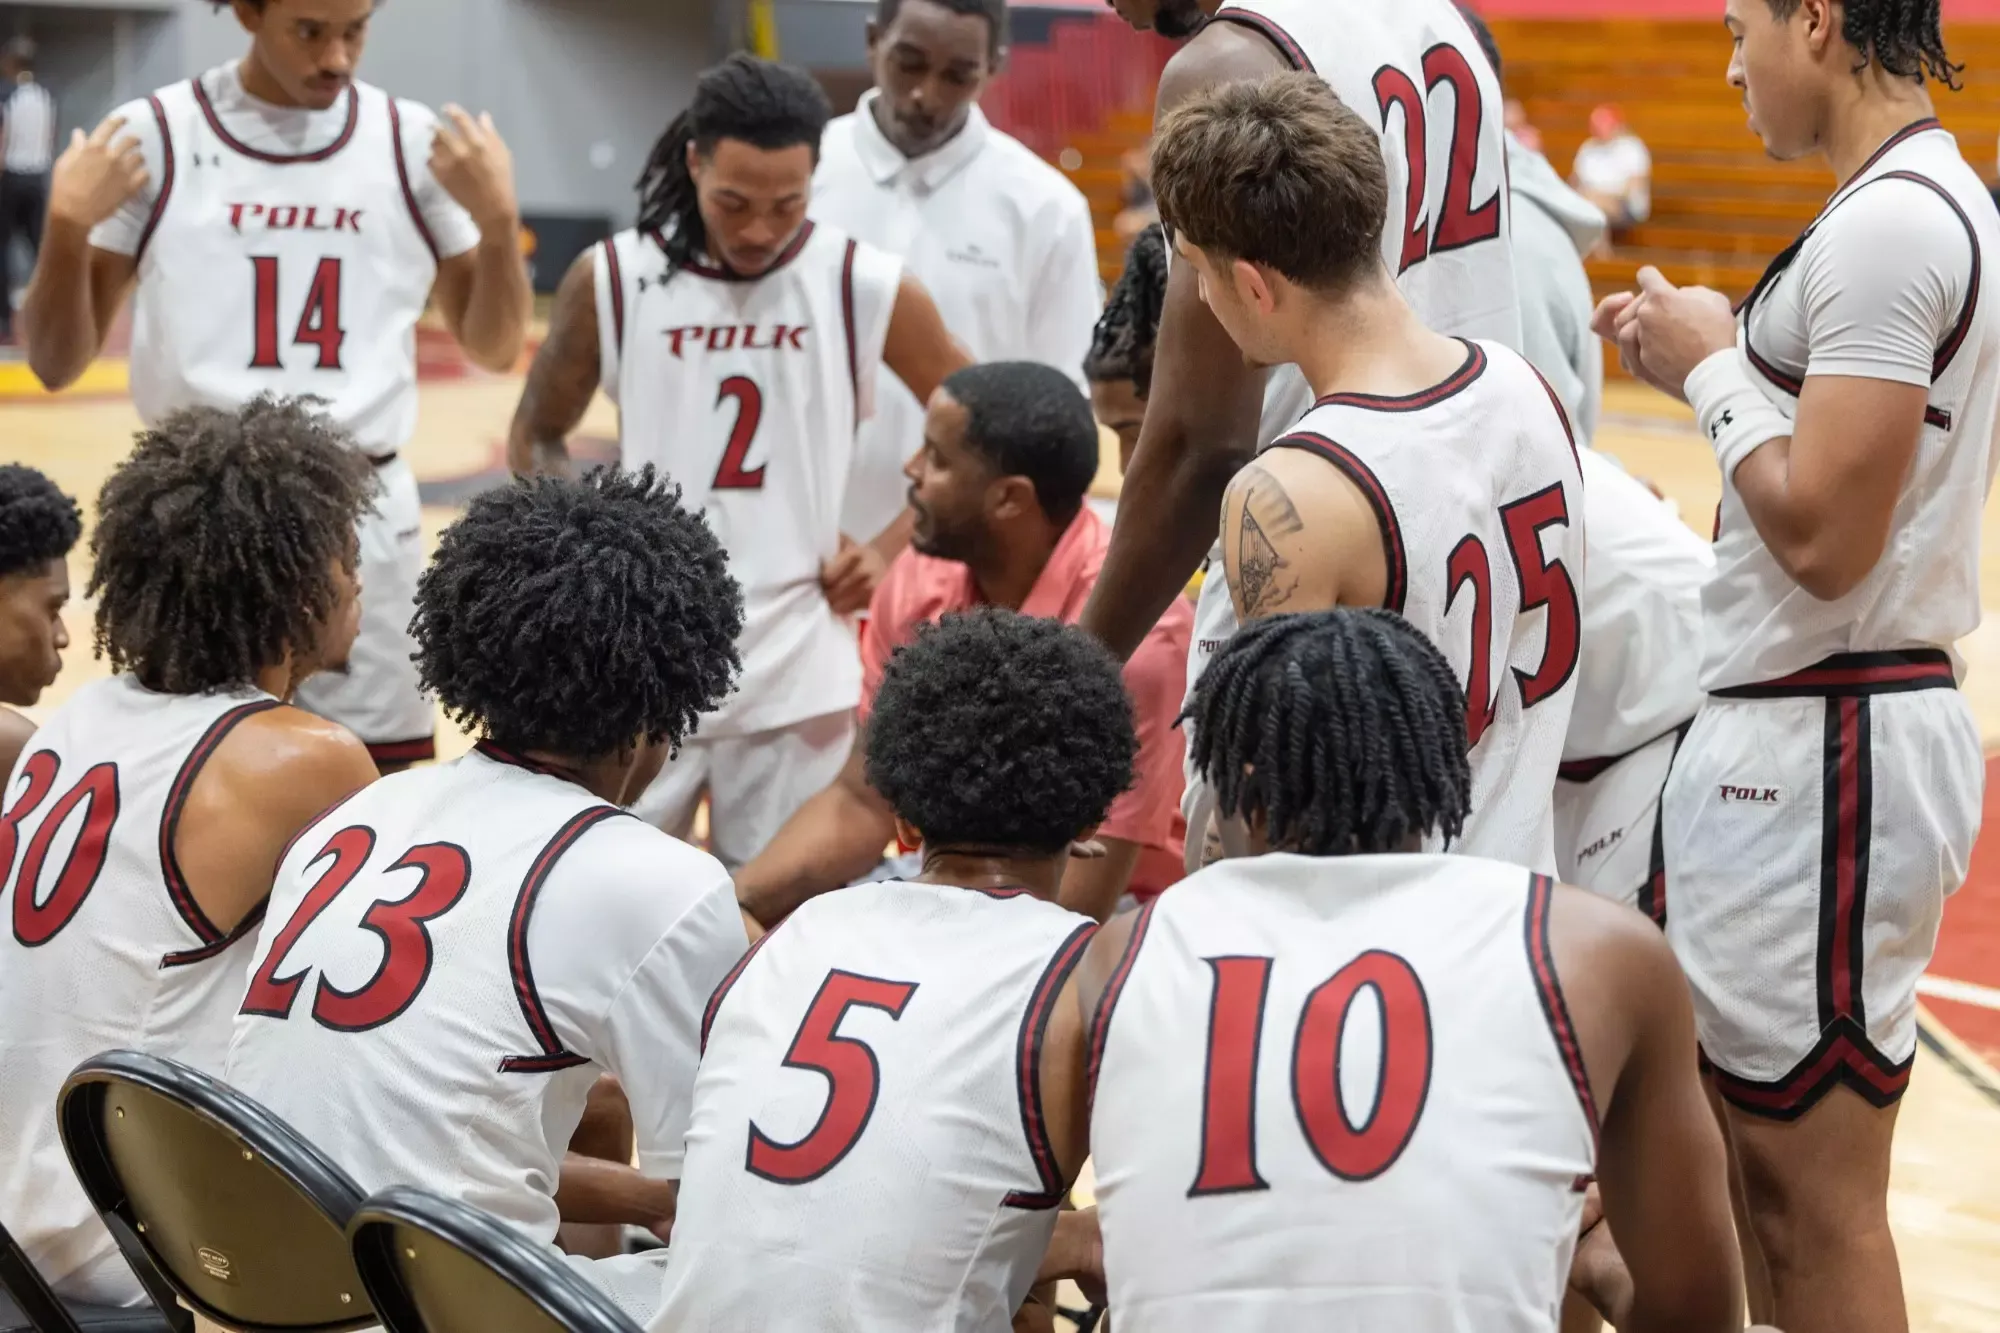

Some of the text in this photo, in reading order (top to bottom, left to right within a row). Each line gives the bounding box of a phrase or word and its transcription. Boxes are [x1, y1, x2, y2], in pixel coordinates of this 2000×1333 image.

[227, 202, 366, 235] POLK
[1371, 42, 1500, 279] 22
[247, 255, 347, 370] 14
[660, 324, 811, 360] POLK
[711, 374, 768, 491] 2
[1444, 480, 1581, 757] 25
[0, 749, 120, 947] 30
[1719, 784, 1779, 801] POLK
[238, 824, 472, 1033] 23
[745, 968, 920, 1185] 5
[1186, 948, 1433, 1199] 10
